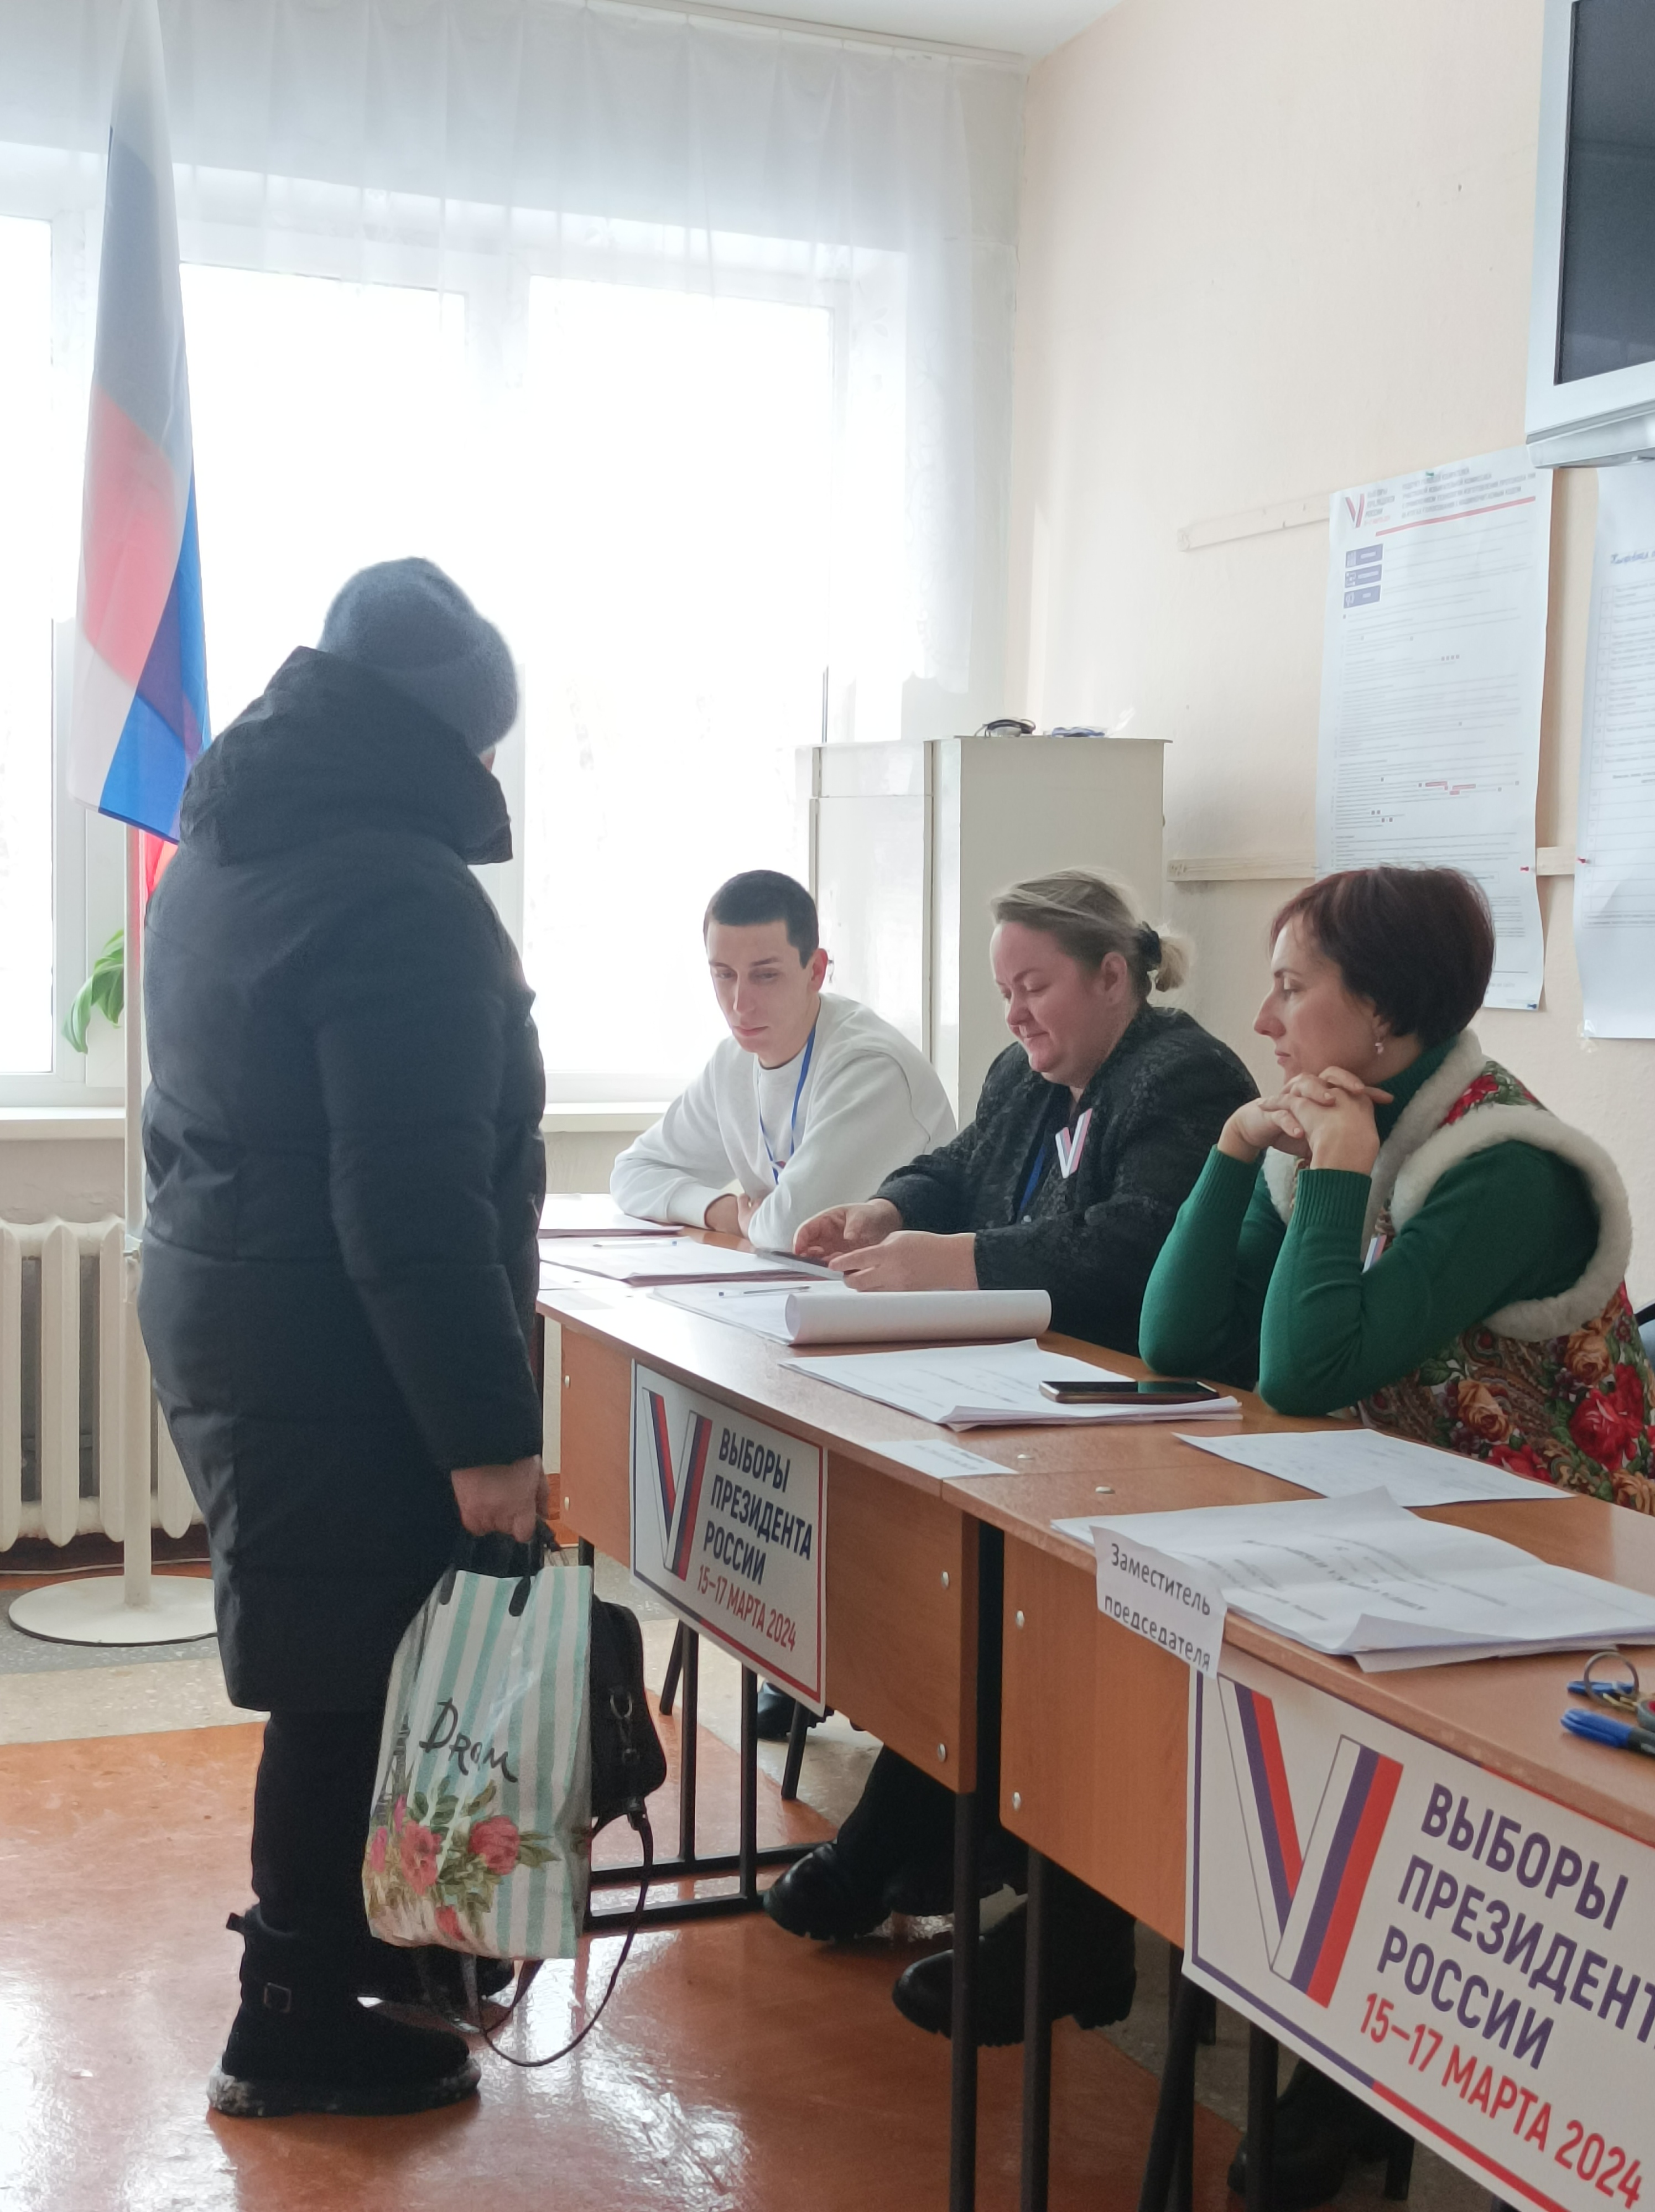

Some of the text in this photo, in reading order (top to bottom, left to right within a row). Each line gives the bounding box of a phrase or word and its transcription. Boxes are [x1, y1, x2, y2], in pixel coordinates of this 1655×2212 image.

[719, 1427, 791, 1493] ВЫБОРЫ
[703, 1520, 767, 1585] РОССИИ
[710, 1474, 813, 1561] ПРЕЗИДЕНТА
[726, 1582, 766, 1633] МАРТА
[766, 1608, 797, 1653] 2024
[1111, 1542, 1211, 1616] Заместитель
[1104, 1595, 1211, 1672] председателя
[1421, 1783, 1629, 1931] ВЫБОРЫ
[1398, 1855, 1655, 2049] ПРЕЗИДЕНТ
[1377, 1925, 1554, 2070] РОССИИ
[1441, 2044, 1552, 2153] МАРТА
[1554, 2119, 1642, 2210] 2024
